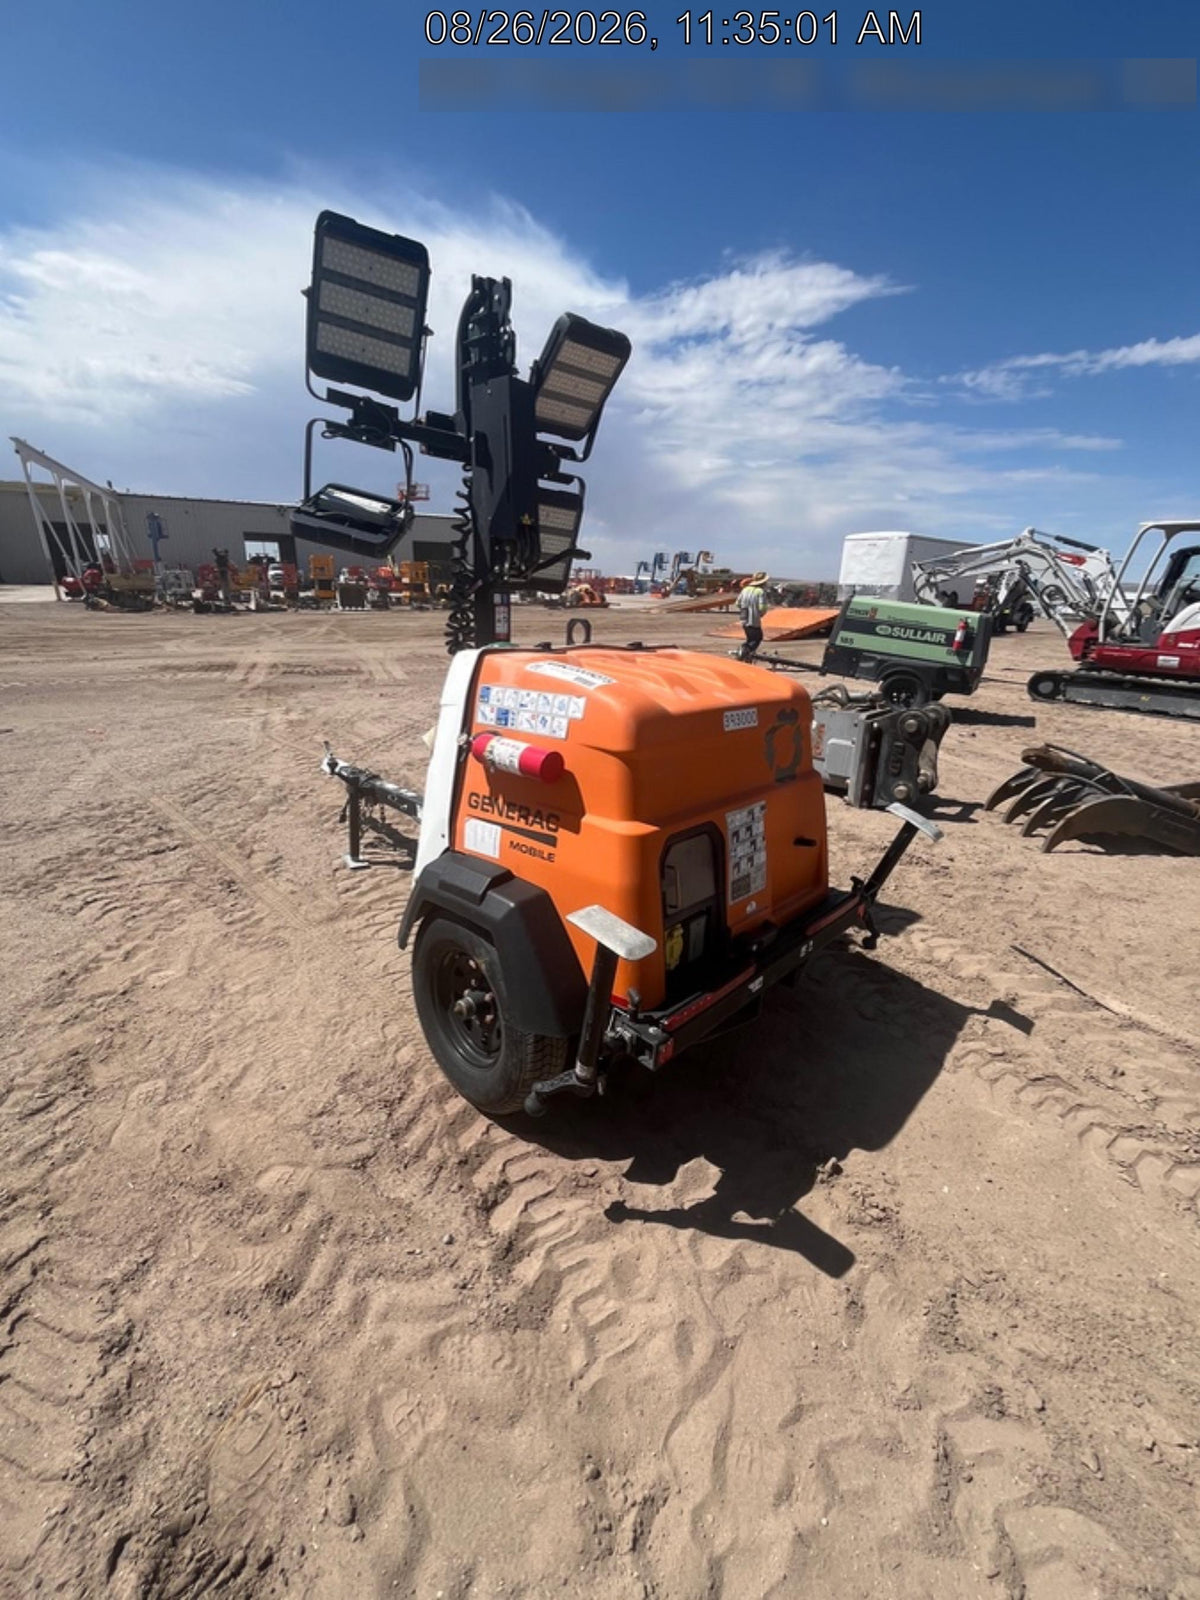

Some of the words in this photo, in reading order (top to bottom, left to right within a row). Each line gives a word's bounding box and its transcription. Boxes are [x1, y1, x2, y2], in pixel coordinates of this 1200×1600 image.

[891, 626, 946, 643] SULLAIR
[467, 791, 560, 833] GENERAC
[509, 839, 556, 863] MOBILE
